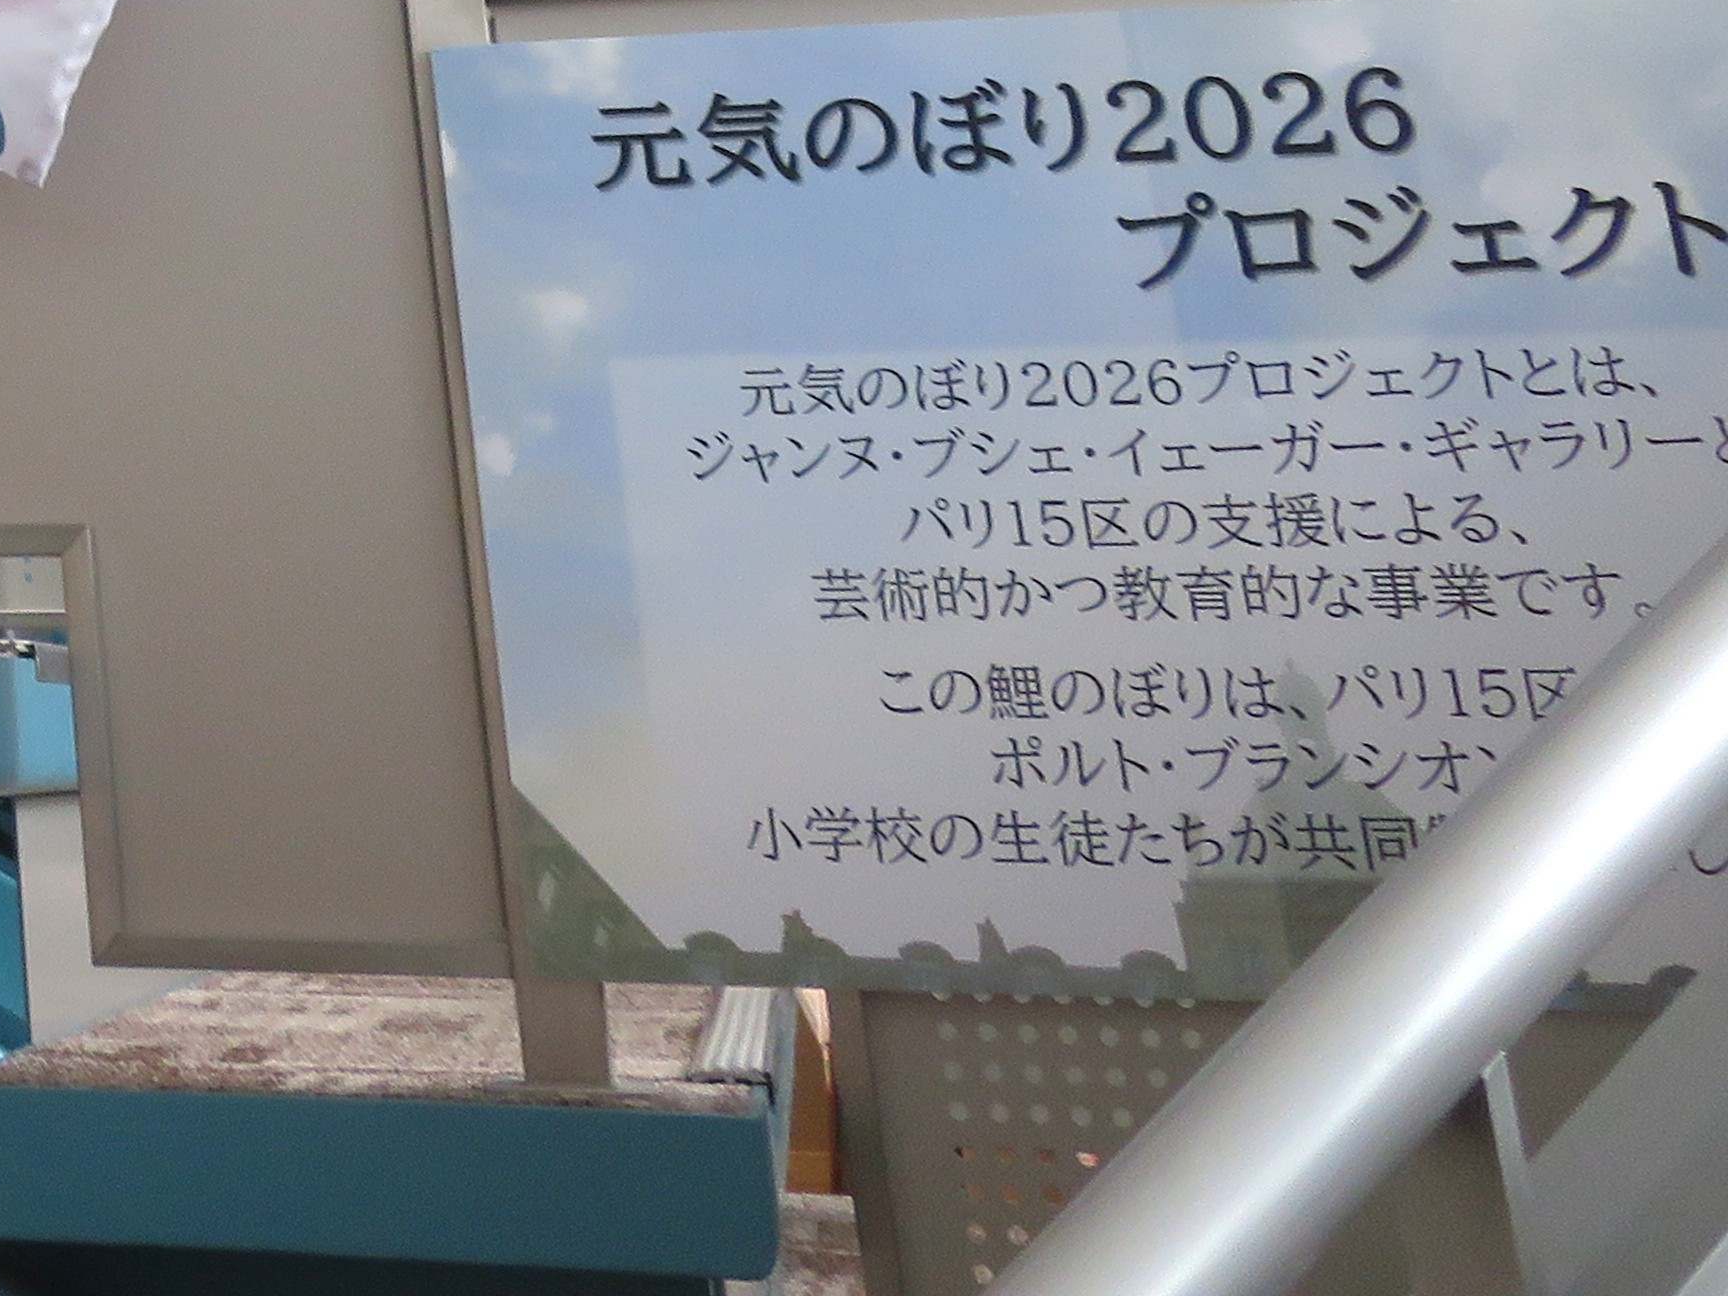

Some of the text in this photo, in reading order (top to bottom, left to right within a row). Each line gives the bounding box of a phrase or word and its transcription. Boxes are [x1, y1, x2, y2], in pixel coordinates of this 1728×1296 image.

[592, 67, 1415, 193] 元気のぼり2026
[1118, 179, 1728, 290] プロジェクト
[741, 347, 1657, 415] 元気のぼり2026プロジェクトとは、
[686, 416, 1728, 482] ジャンヌ・ブシェ・イェーガー・ギャラリー
[900, 492, 1528, 549] パリ15区の支援による、
[812, 563, 1653, 622] 芸術的かつ教育的な事業です。
[990, 736, 1496, 793] ポルト・ブランシオ
[748, 807, 1446, 871] 小学校の生徒たちが共同
